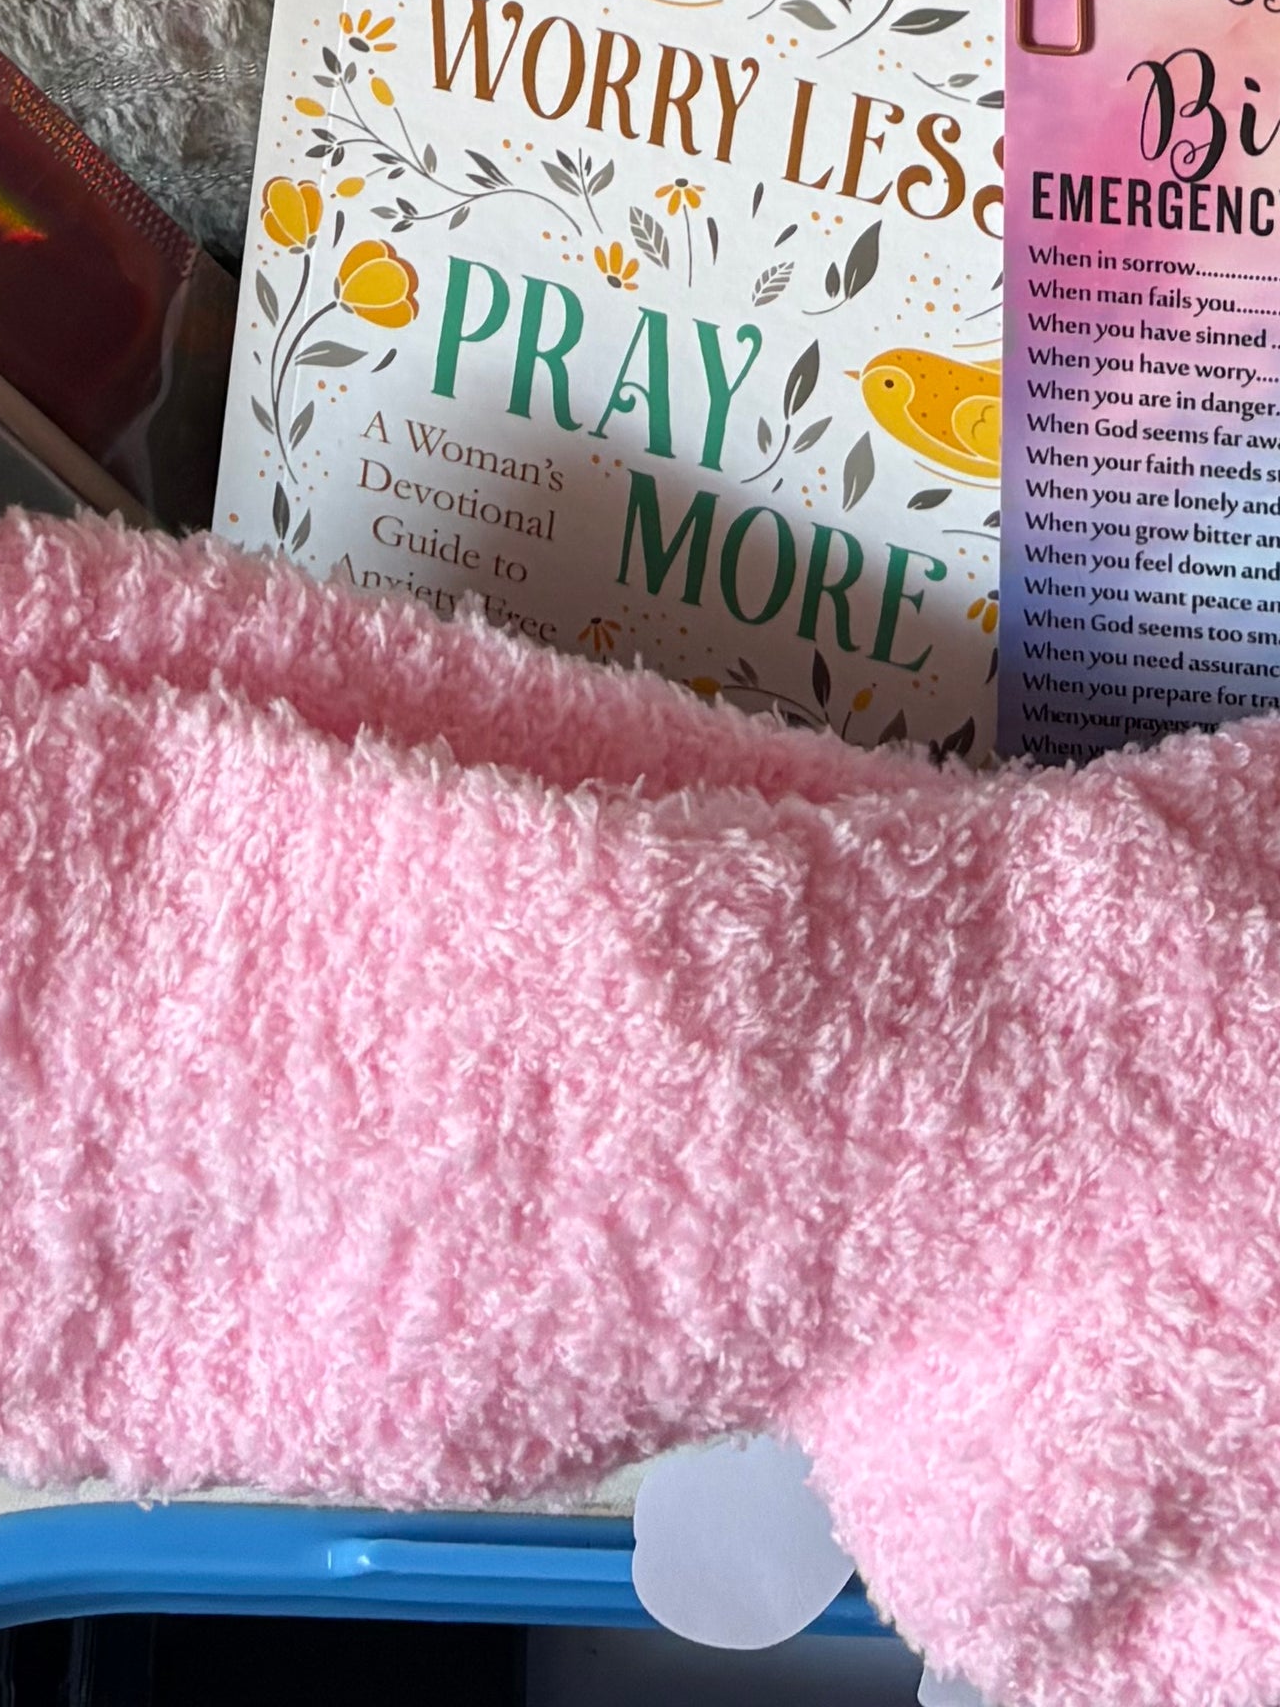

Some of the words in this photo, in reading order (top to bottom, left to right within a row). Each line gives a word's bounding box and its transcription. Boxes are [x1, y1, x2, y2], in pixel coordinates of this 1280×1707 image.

[1028, 246, 1092, 272] When
[1098, 251, 1117, 272] in
[1121, 257, 1196, 276] sorrow
[1028, 280, 1091, 305] When
[1098, 289, 1143, 307] man
[1148, 287, 1193, 310] fails
[1194, 296, 1236, 316] you
[1028, 313, 1091, 339] When
[1094, 323, 1135, 343] you
[1140, 320, 1191, 342] have
[1196, 327, 1267, 350] sinned
[431, 254, 763, 472] PRAY
[1028, 347, 1091, 371] When
[1094, 357, 1134, 376] you
[1140, 355, 1191, 377] have
[1196, 364, 1257, 387] worry
[1028, 380, 1090, 405] When
[1093, 390, 1133, 409] you
[1138, 391, 1172, 409] are
[1177, 391, 1196, 411] in
[1201, 393, 1277, 421] danger
[1028, 414, 1089, 438] When
[1095, 419, 1137, 440] God
[1142, 426, 1208, 446] seems
[1213, 426, 1242, 447] far
[360, 410, 391, 445] A
[405, 419, 564, 492] Woman's
[1027, 446, 1088, 472] When
[1092, 456, 1142, 478] your
[1146, 454, 1195, 478] faith
[1200, 459, 1262, 483] needs
[357, 457, 554, 541] Devotional
[1027, 480, 1088, 504] When
[1092, 489, 1132, 508] you
[1136, 490, 1169, 508] are
[1174, 490, 1238, 518] lonely
[372, 514, 480, 570] Guide
[493, 554, 528, 583] to
[616, 468, 948, 671] MORE
[1024, 641, 1085, 666] When
[1088, 651, 1129, 670] you
[1133, 651, 1184, 672] need
